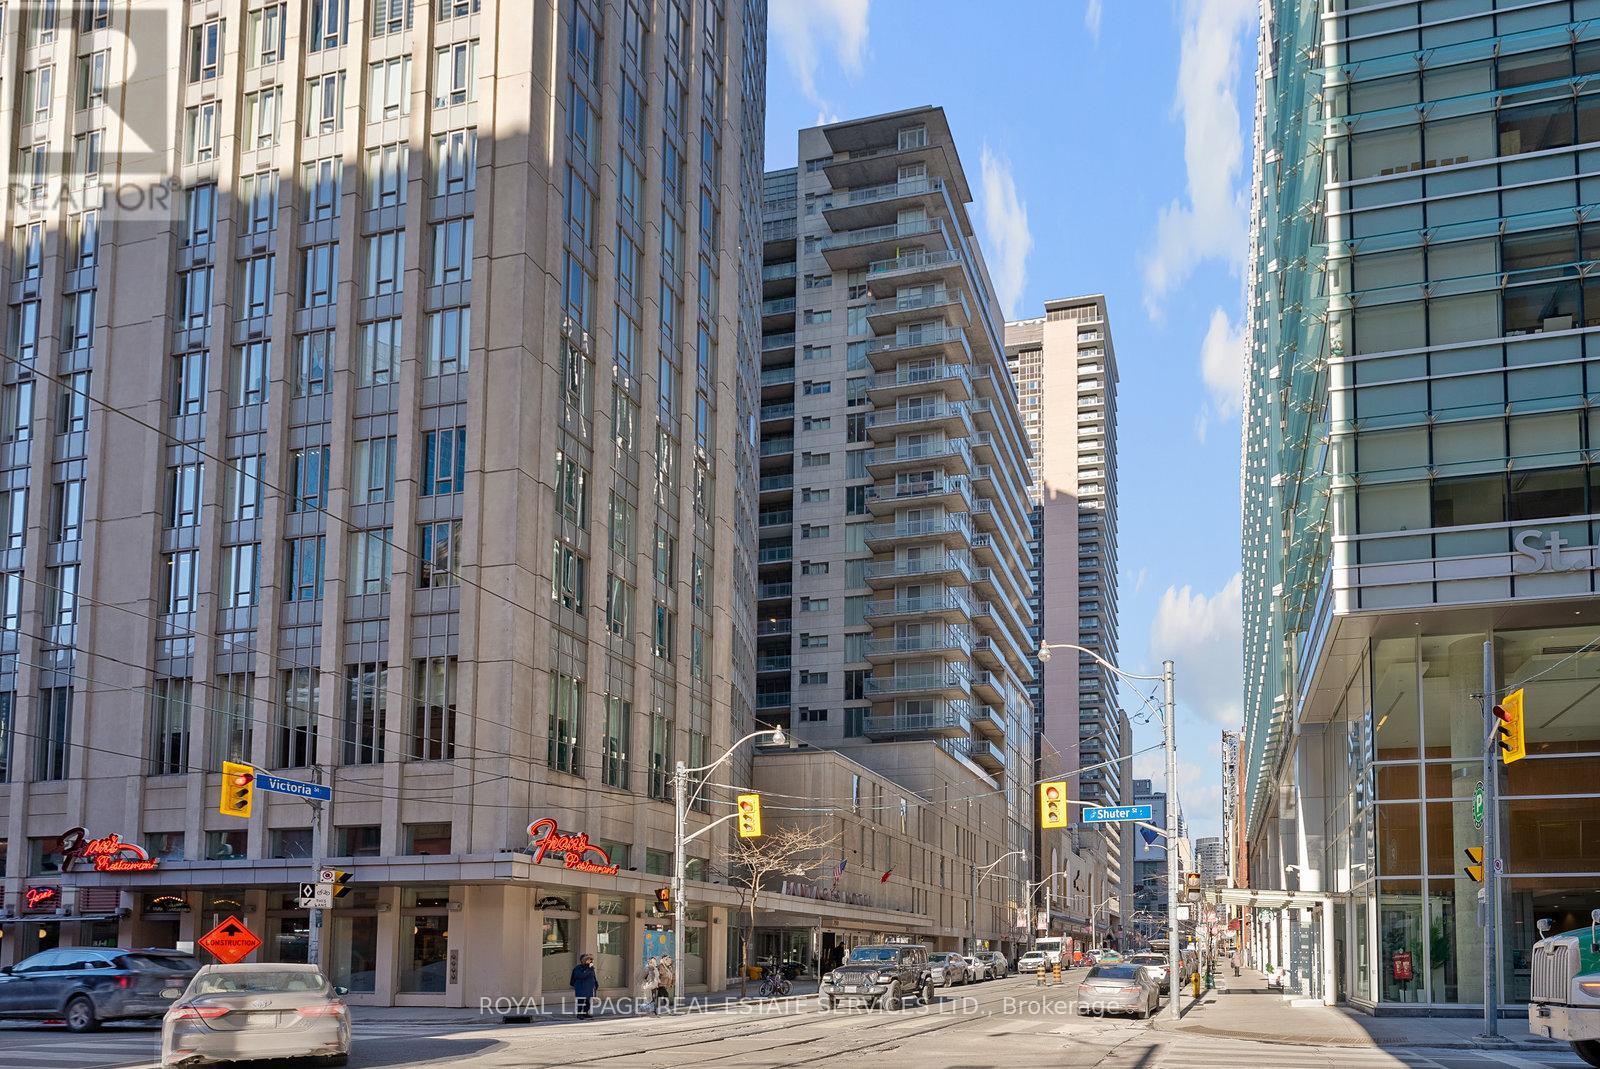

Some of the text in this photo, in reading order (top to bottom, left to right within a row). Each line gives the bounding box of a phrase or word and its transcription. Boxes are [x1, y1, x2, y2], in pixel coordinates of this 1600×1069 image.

[268, 777, 311, 795] Victoria
[1097, 808, 1130, 819] Shuter
[563, 851, 620, 875] Restaurant
[205, 938, 257, 947] CONSTRUCTION
